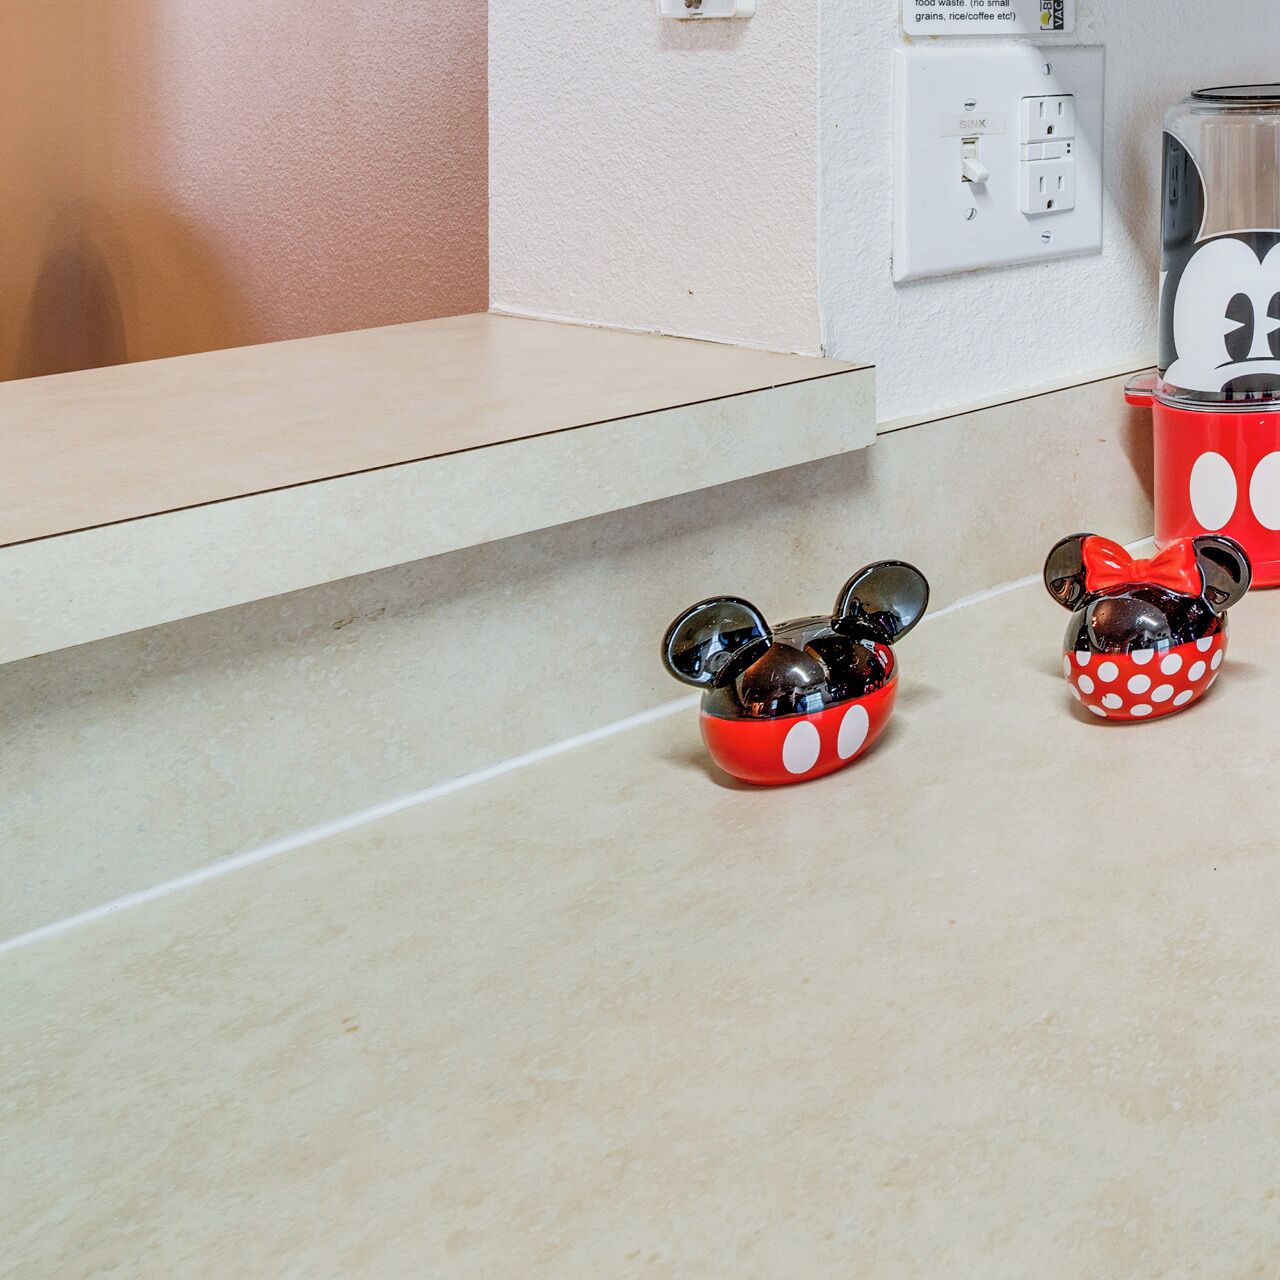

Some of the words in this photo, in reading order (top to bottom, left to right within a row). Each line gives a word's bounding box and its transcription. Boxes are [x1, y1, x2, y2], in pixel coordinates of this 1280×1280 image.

[915, 13, 946, 21] grains,
[949, 12, 994, 20] rice/coffee
[960, 119, 986, 128] SINK
